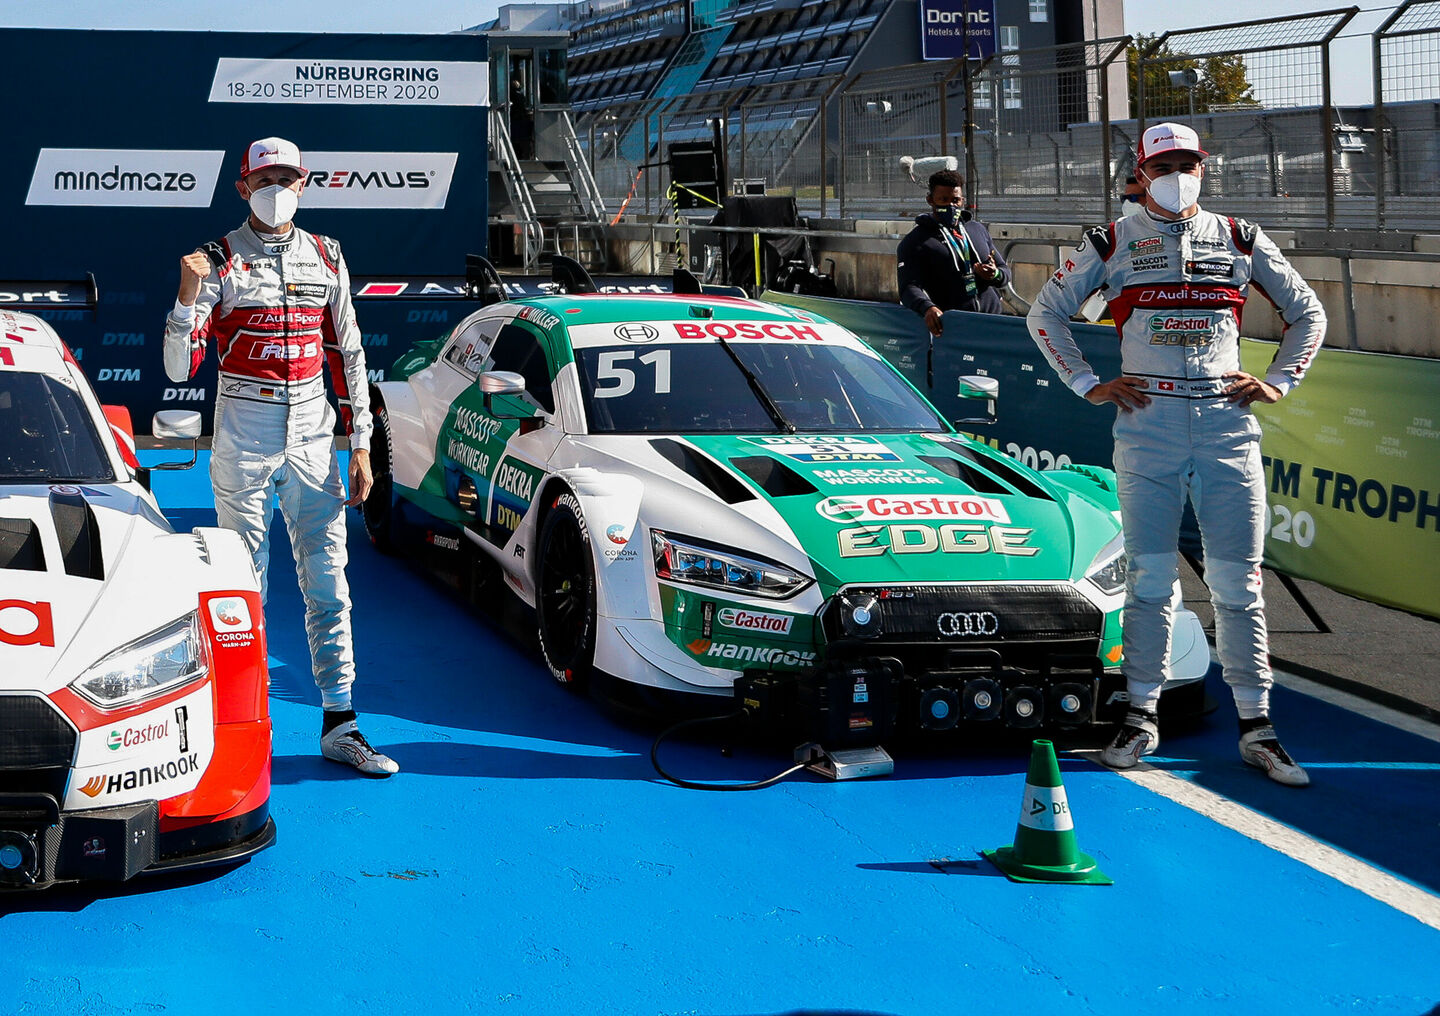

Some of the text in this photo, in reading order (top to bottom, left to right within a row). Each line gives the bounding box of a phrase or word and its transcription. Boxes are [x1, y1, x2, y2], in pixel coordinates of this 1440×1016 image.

[926, 8, 990, 24] Dornt
[928, 27, 953, 37] Hotels
[296, 62, 439, 82] NÜRBURGRING
[227, 82, 440, 100] 18-20 SEPTEMBER 2020
[53, 164, 197, 192] mindmaze
[1156, 290, 1227, 302] Audi Sport
[264, 313, 322, 325] Audi Sport
[526, 308, 561, 332] MÜLLER
[1163, 317, 1210, 331] Castrol
[101, 332, 145, 346] DTM
[672, 322, 824, 342] BOSCH
[1043, 337, 1060, 357] Audi
[97, 367, 141, 382] DTM
[594, 349, 671, 400] 51
[162, 387, 206, 401] DTM
[1412, 417, 1433, 428] DTM
[763, 435, 869, 445] DEKRA
[807, 443, 852, 454] 51
[1375, 444, 1408, 459] TROPHY
[447, 437, 490, 477] WORKWEAR
[810, 452, 885, 462] DTM
[498, 462, 534, 502] DEKRA
[823, 476, 945, 486] WORKWEAR
[1312, 467, 1440, 532] TROPH
[867, 496, 1000, 519] Castrol
[496, 503, 522, 532] DTM
[837, 523, 1041, 559] EDGE
[604, 549, 638, 557] CORONA
[735, 611, 789, 633] Castrol
[215, 632, 255, 643] CORONA
[1106, 690, 1130, 705] AB
[123, 719, 169, 748] Castrol
